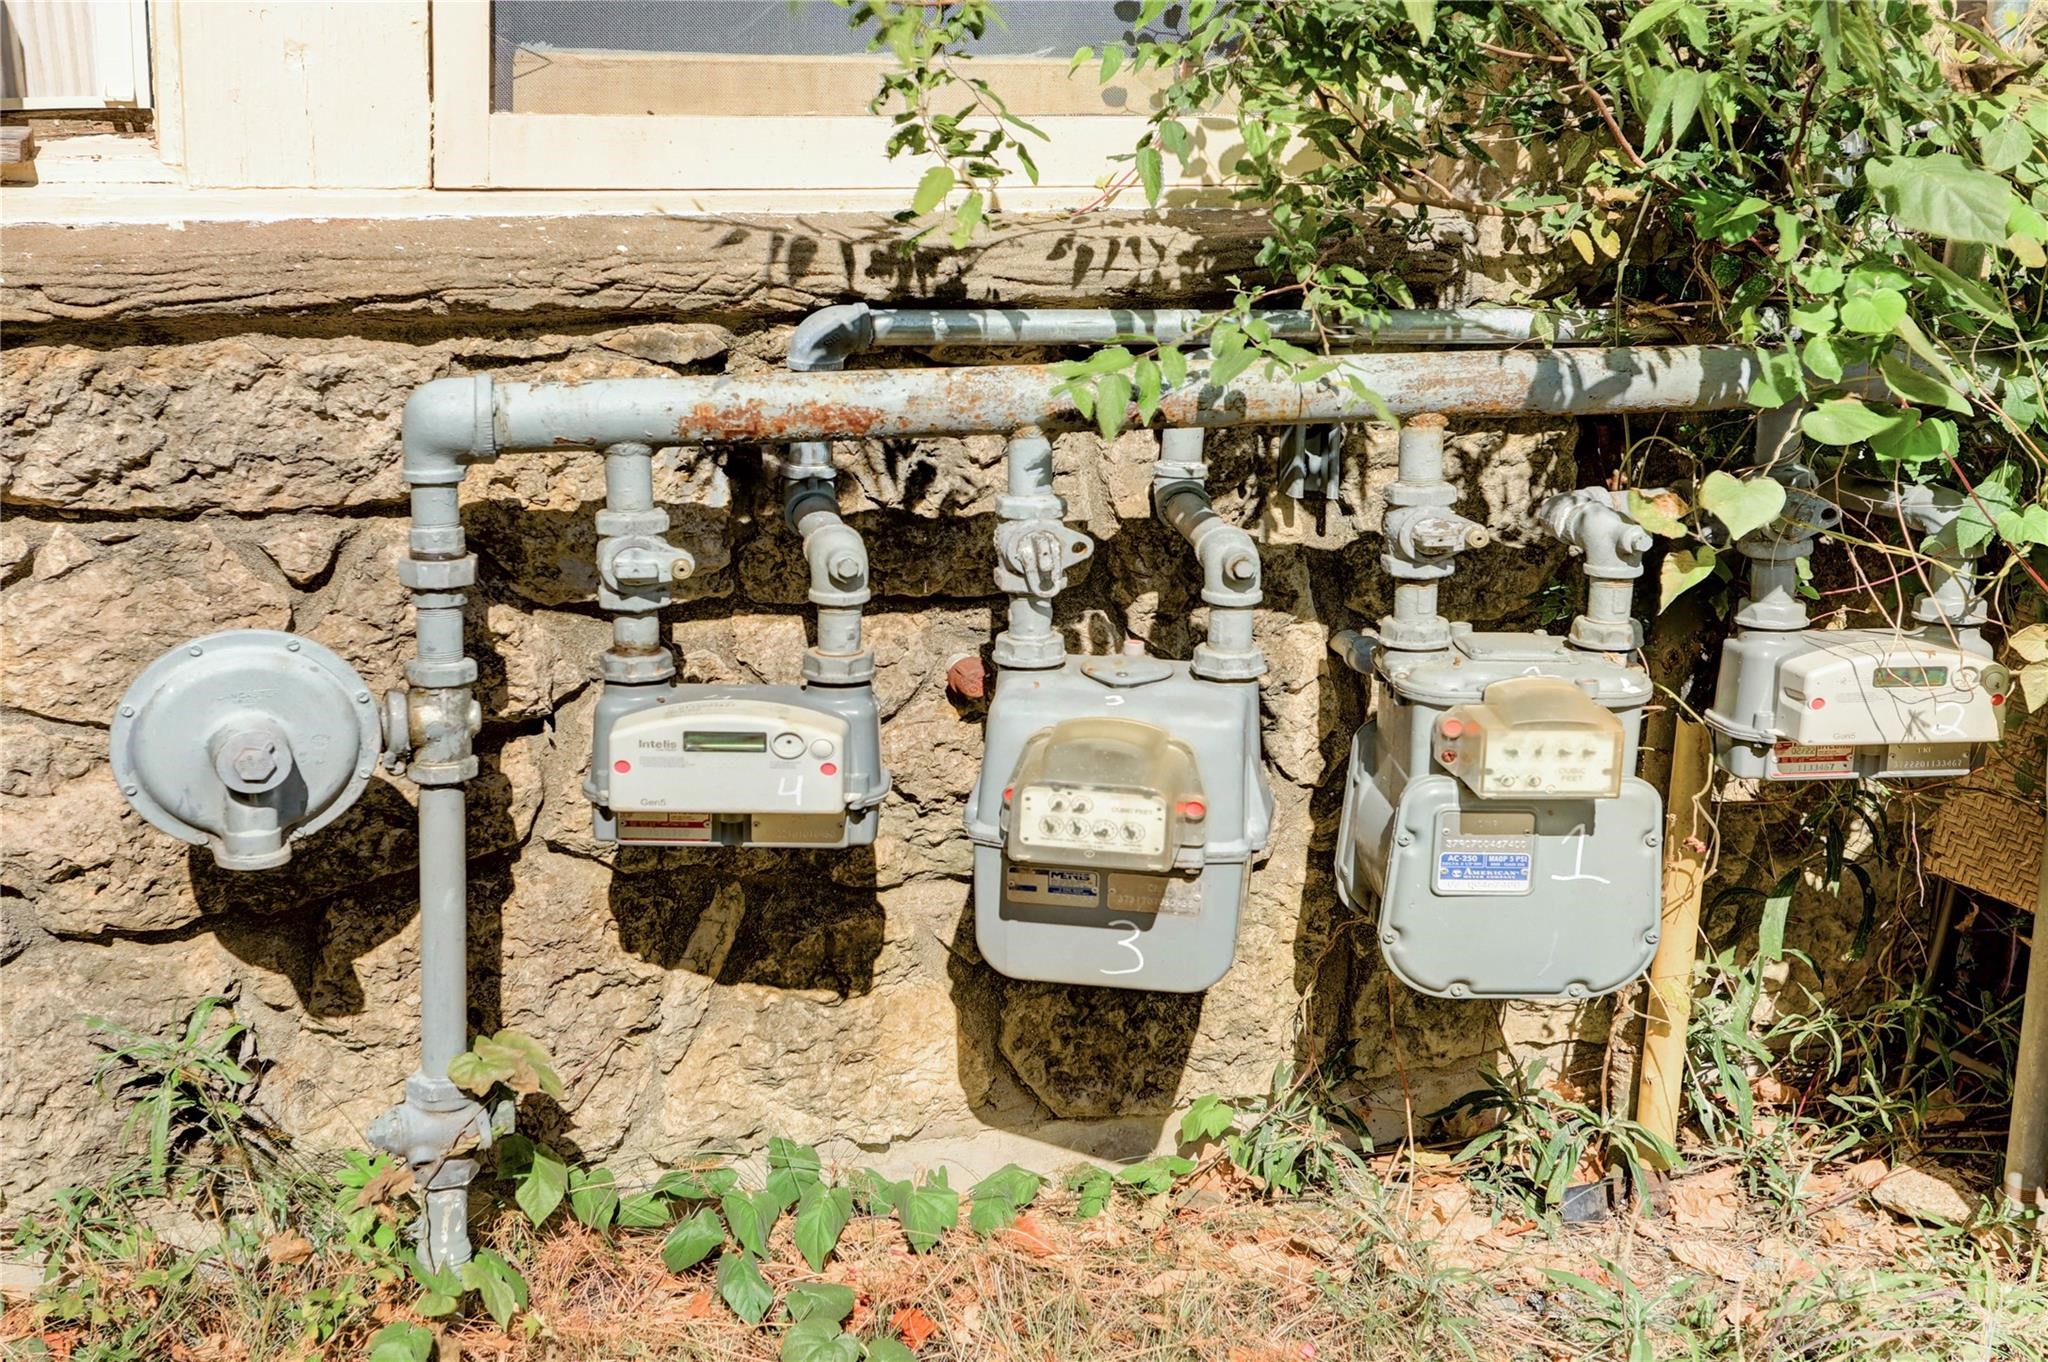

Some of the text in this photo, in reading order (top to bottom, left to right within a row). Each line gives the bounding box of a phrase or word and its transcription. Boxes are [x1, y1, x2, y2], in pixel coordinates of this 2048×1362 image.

[1930, 702, 1967, 738] 2
[638, 739, 678, 749] Intelis
[778, 775, 804, 806] 4
[1551, 823, 1611, 885] 1
[1100, 920, 1144, 974] 3
